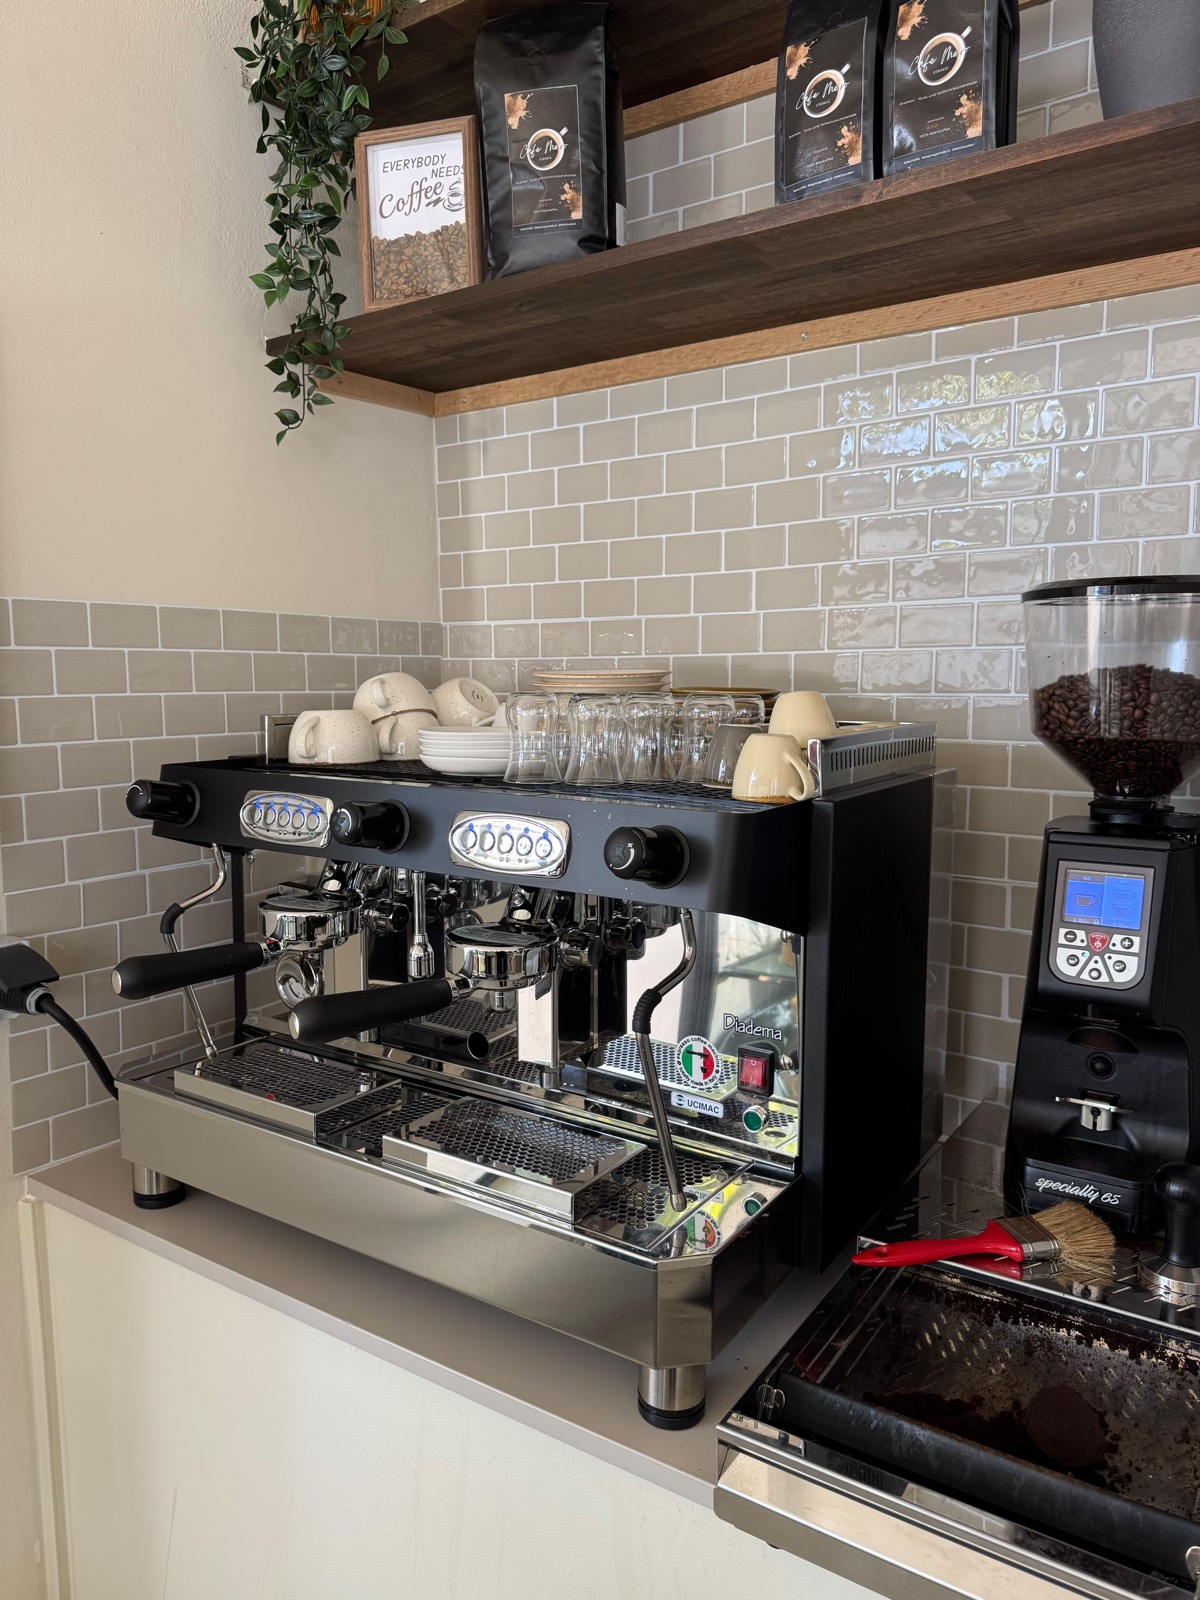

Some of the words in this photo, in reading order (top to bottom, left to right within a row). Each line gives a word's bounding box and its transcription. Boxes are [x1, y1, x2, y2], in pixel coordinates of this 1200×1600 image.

[382, 153, 447, 173] EVERYBODY
[378, 176, 445, 219] Coffee
[723, 1013, 782, 1041] Diadema
[686, 1098, 720, 1115] UCIMAC
[1034, 1178, 1099, 1203] specialty
[1100, 1193, 1121, 1204] 65
